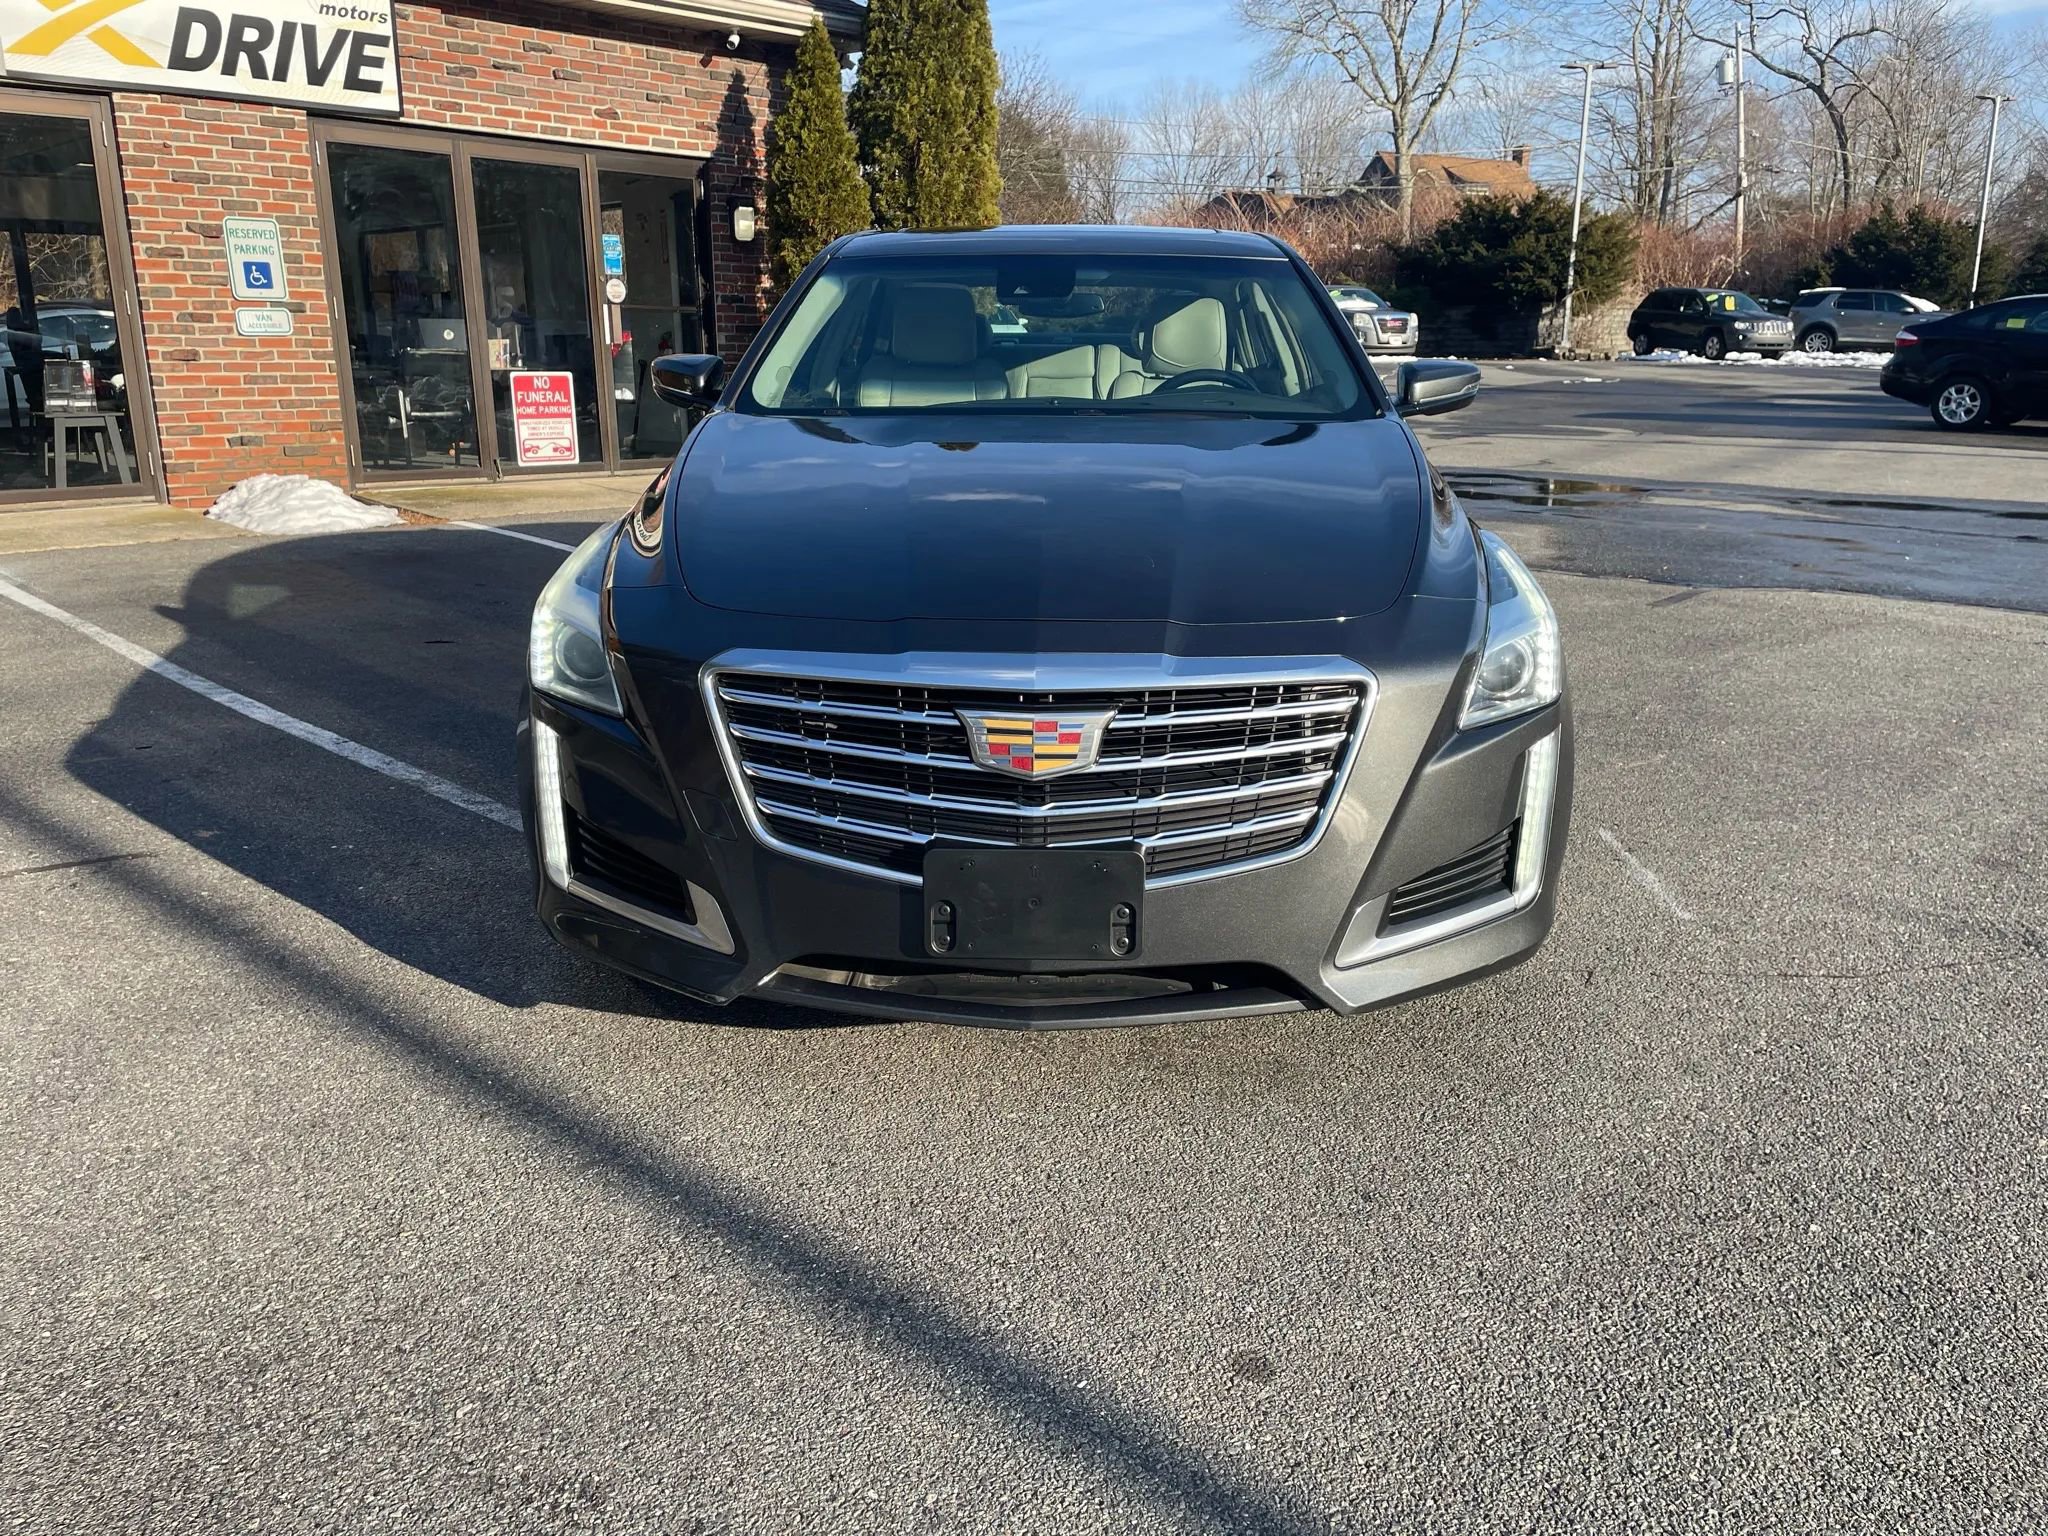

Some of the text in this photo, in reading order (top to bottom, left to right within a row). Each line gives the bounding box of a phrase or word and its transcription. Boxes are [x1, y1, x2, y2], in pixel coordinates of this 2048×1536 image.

[319, 4, 388, 24] motors
[167, 6, 391, 94] DRIVE
[229, 227, 276, 240] RESERVED
[234, 243, 275, 256] PARKING
[255, 313, 273, 322] VAN
[533, 376, 550, 389] NO
[517, 391, 568, 403] FUNERAL
[516, 405, 572, 415] HOME PARKING
